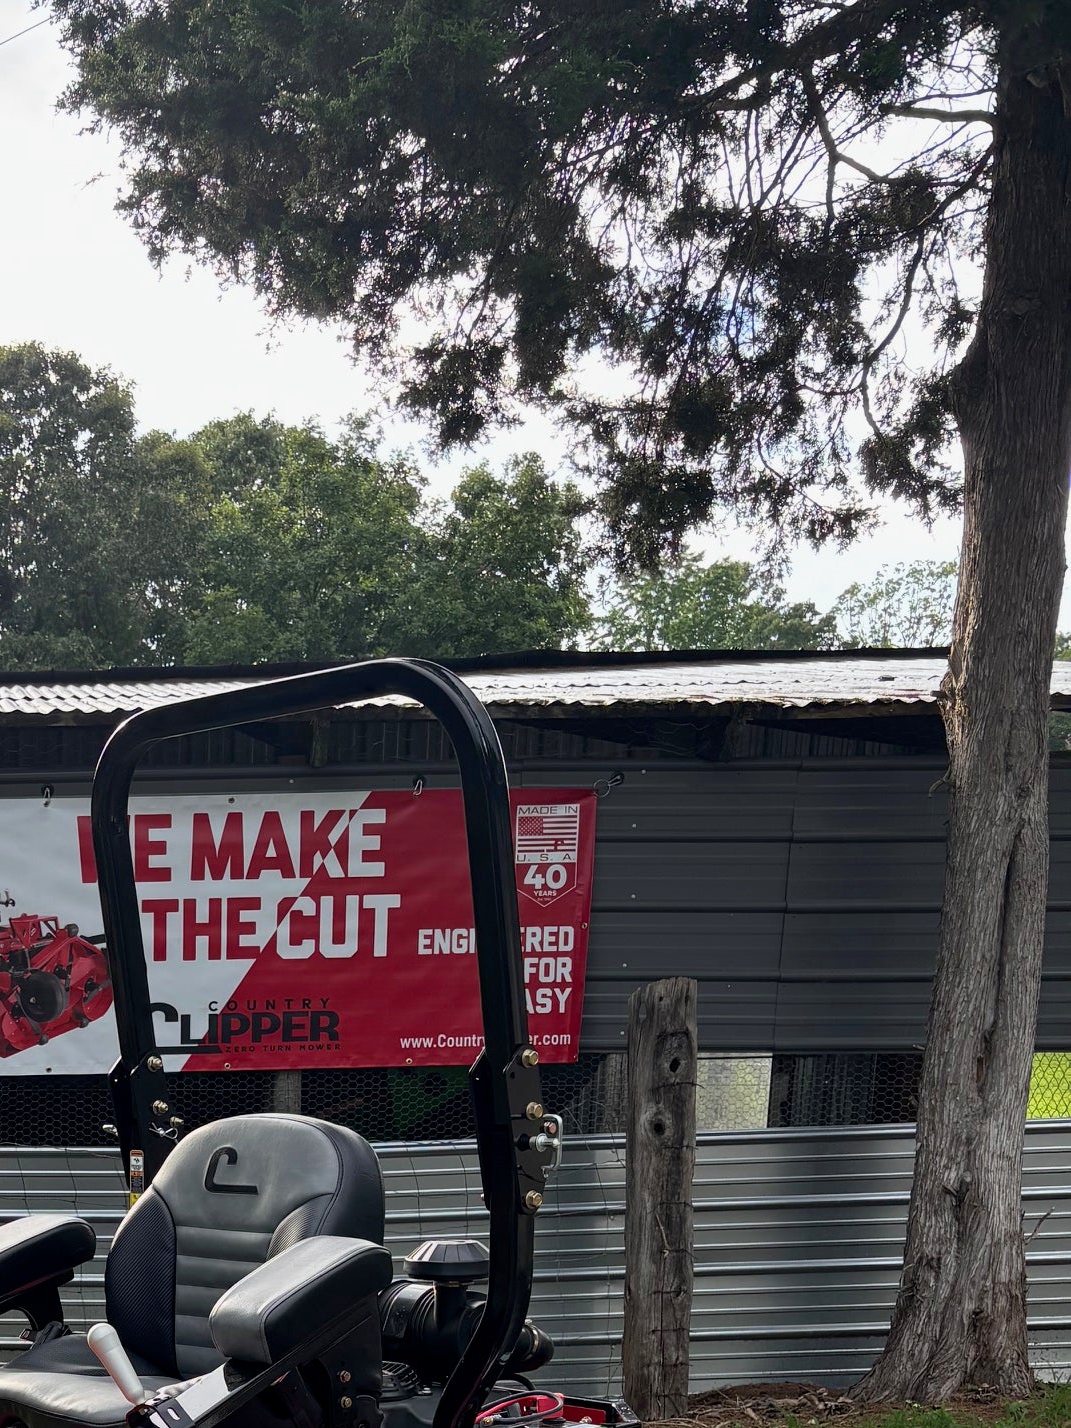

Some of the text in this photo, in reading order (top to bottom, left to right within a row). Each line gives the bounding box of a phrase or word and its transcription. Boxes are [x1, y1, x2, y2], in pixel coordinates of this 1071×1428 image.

[518, 805, 578, 815] MADE IN
[190, 808, 387, 882] MAKE
[523, 863, 568, 890] 40
[141, 893, 402, 962] THE CUT
[523, 956, 573, 984] FOR
[208, 998, 331, 1012] COUNTRY
[226, 1043, 341, 1053] ZERO TURN MOWER
